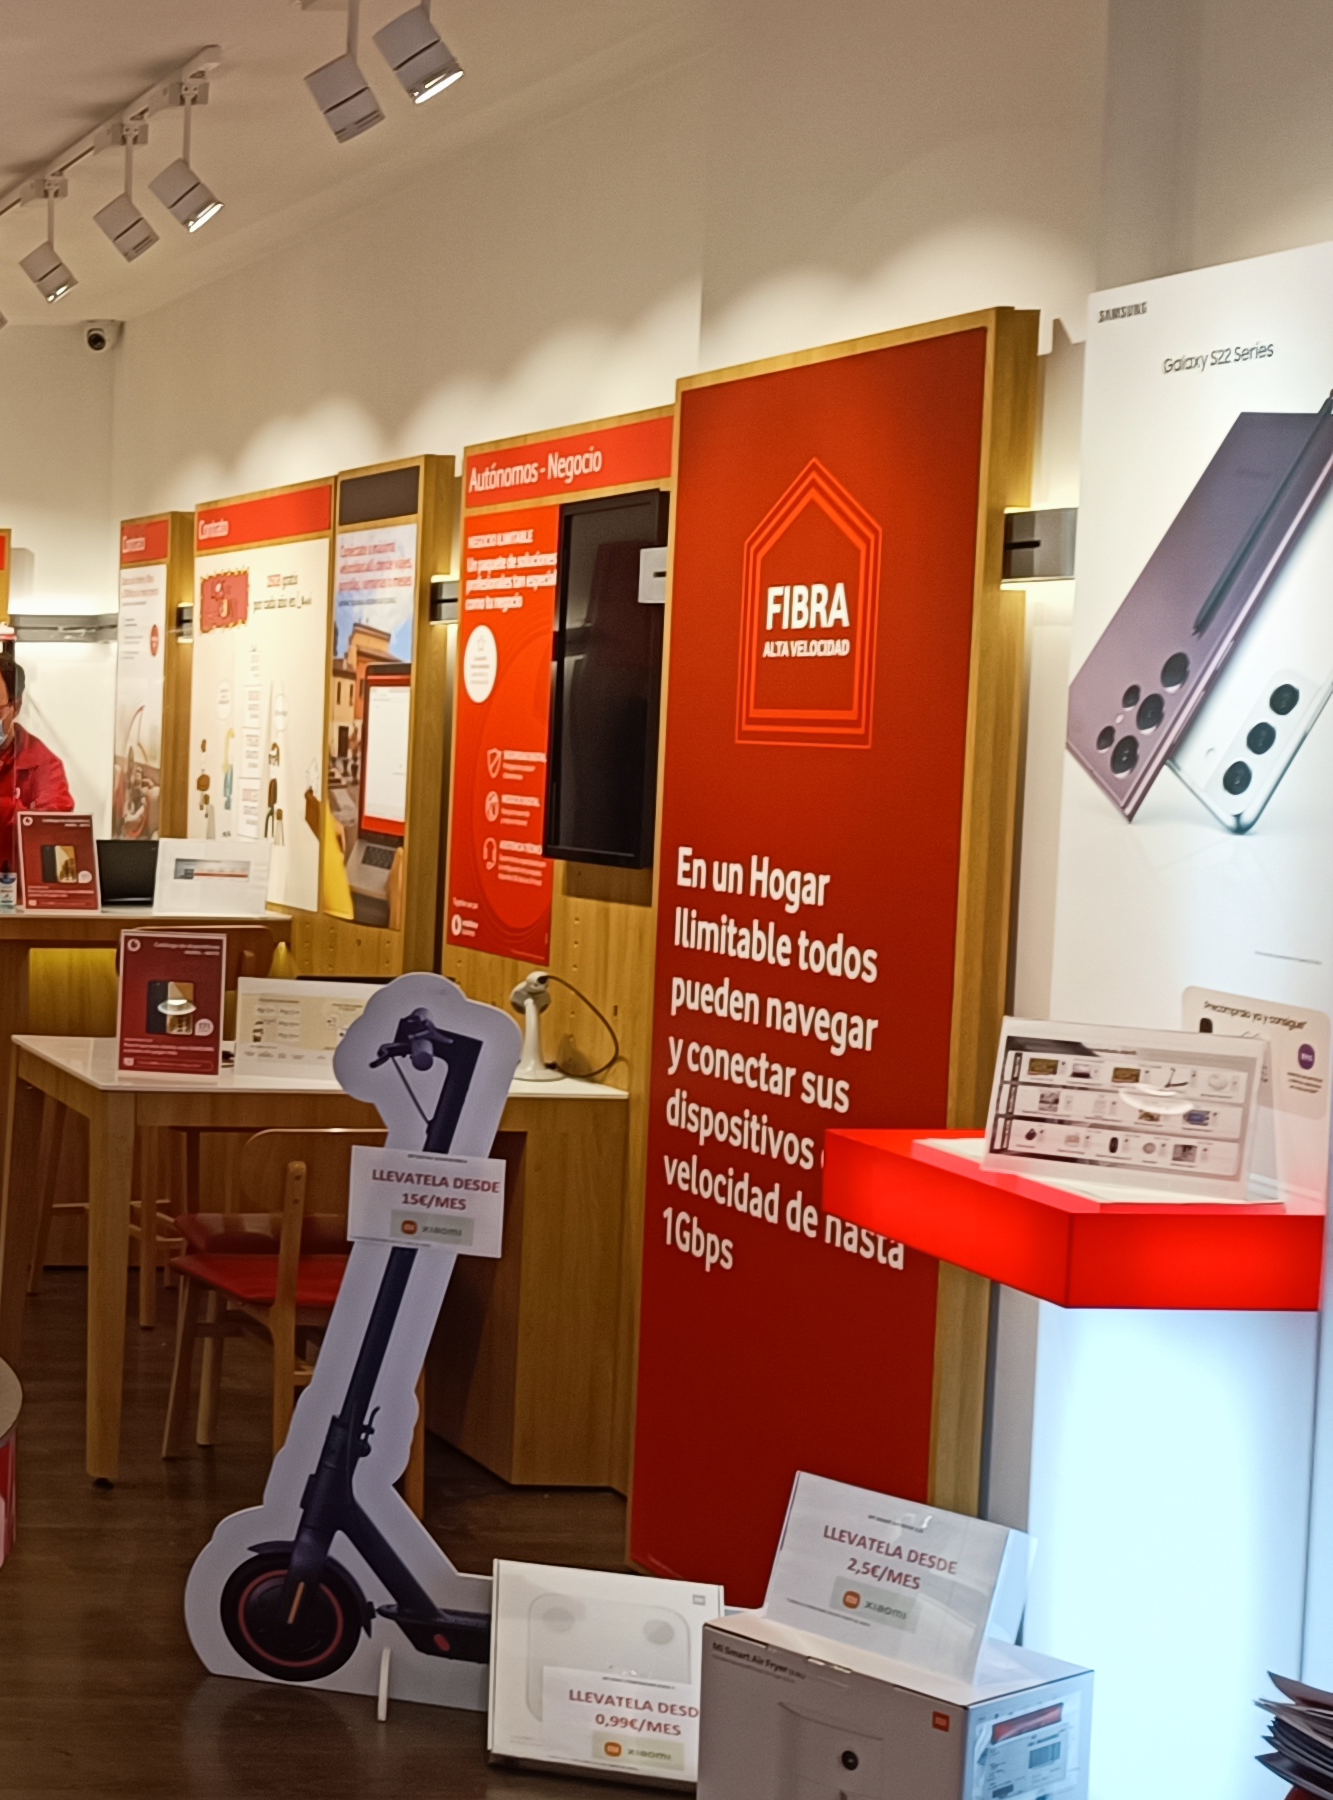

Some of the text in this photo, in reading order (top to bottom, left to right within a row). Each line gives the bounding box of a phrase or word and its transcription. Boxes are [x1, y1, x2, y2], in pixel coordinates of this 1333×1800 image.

[1098, 301, 1147, 323] SAMSUNG
[1164, 342, 1274, 374] Galaxy S22 Series
[469, 455, 539, 493] Autónomos
[548, 446, 602, 480] Negocio
[766, 582, 850, 630] FIBRA
[763, 639, 850, 657] ALTA VELOCIDAD
[677, 846, 830, 914] En un Hogar
[674, 906, 878, 983] Ilimitable todos
[671, 976, 878, 1056] pueden navegar
[667, 1036, 850, 1113] y conectar sus
[666, 1088, 814, 1170] dispositivos
[372, 1169, 501, 1193] LLEVATELA DESDE
[402, 1193, 466, 1210] 15€/MES
[664, 1154, 779, 1225] velocidad
[786, 1191, 818, 1238] de
[663, 1207, 734, 1272] 1Gbps
[823, 1525, 958, 1575] LLEVATELA DESDE
[847, 1557, 921, 1590] 2,5€/MES
[725, 1646, 750, 1660] Smart
[569, 1689, 699, 1718] LLEVATELA DESD
[595, 1713, 681, 1736] 0,99€/MES
